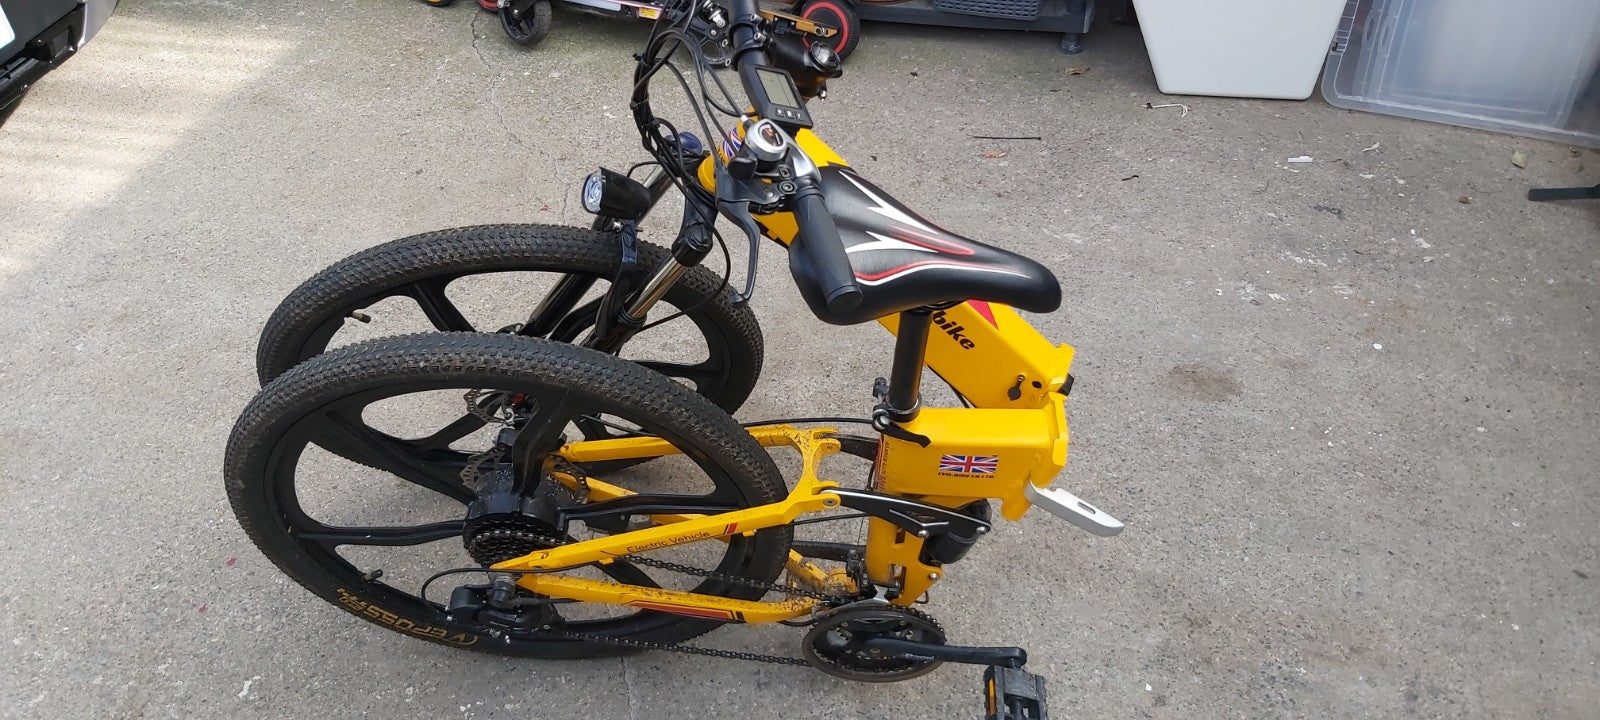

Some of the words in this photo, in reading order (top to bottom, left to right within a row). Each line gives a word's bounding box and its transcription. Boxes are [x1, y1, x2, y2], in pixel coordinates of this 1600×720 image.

[932, 310, 975, 350] bike
[626, 540, 668, 553] Electric
[669, 530, 711, 545] Vehicle
